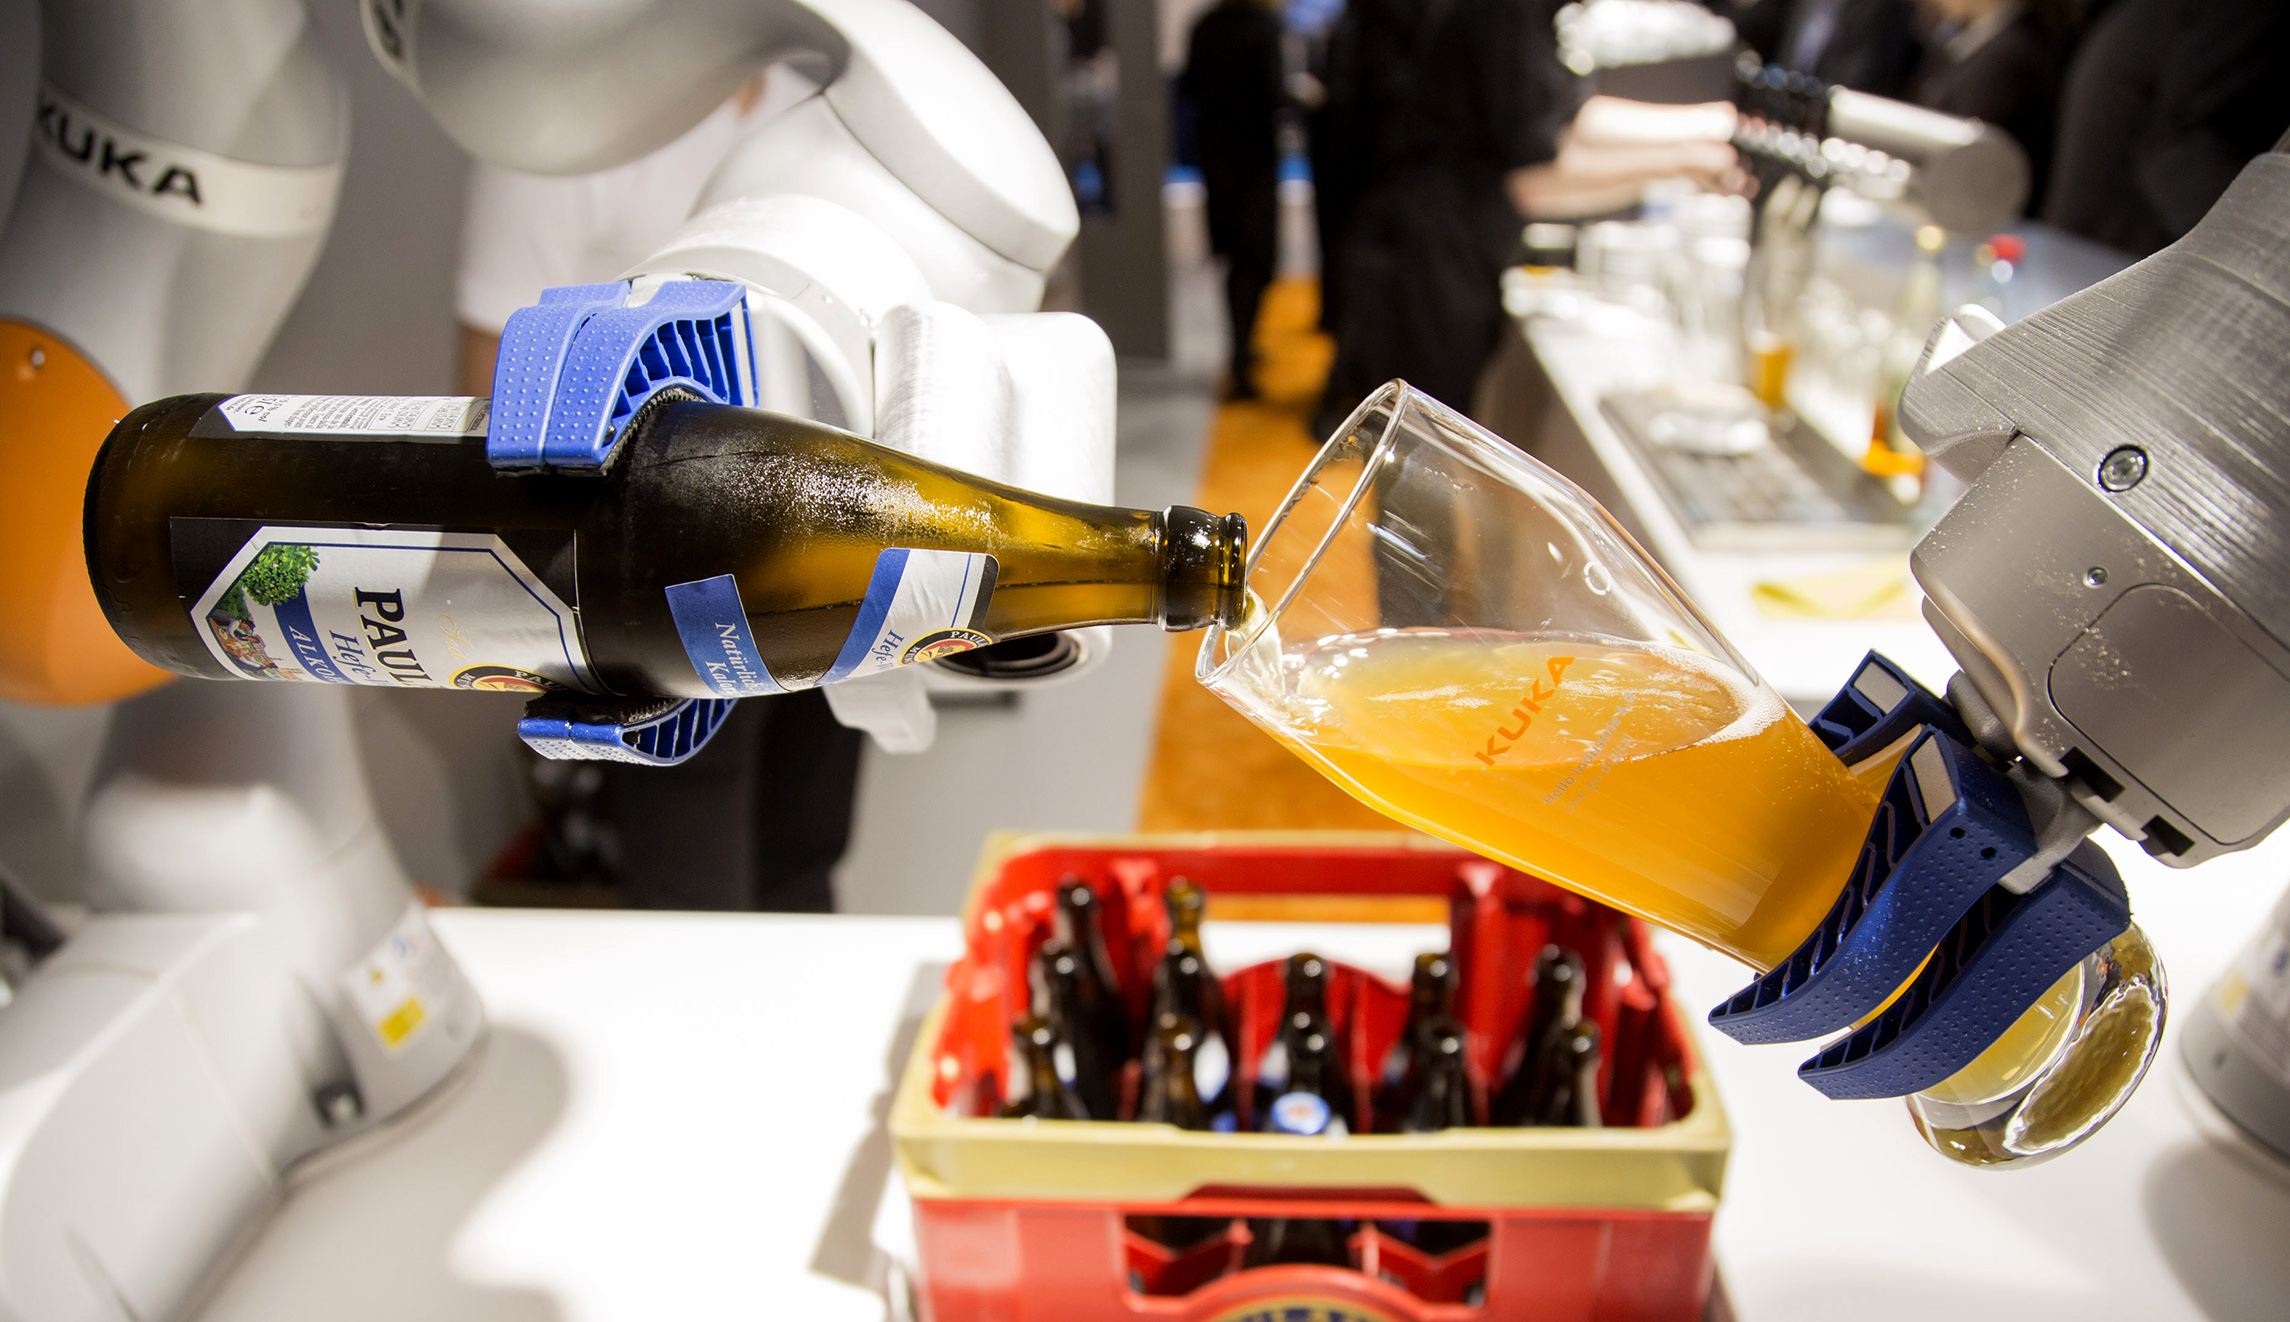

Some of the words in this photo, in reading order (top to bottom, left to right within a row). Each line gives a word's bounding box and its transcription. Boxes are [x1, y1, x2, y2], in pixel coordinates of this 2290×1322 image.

[329, 629, 389, 684] Hefe-
[1474, 656, 1575, 767] KUKA
[1542, 776, 1576, 805] Hello
[1571, 716, 1622, 775] Industrie
[1616, 691, 1635, 716] 4.0
[1586, 774, 1603, 793] go
[1600, 731, 1634, 775] digital
